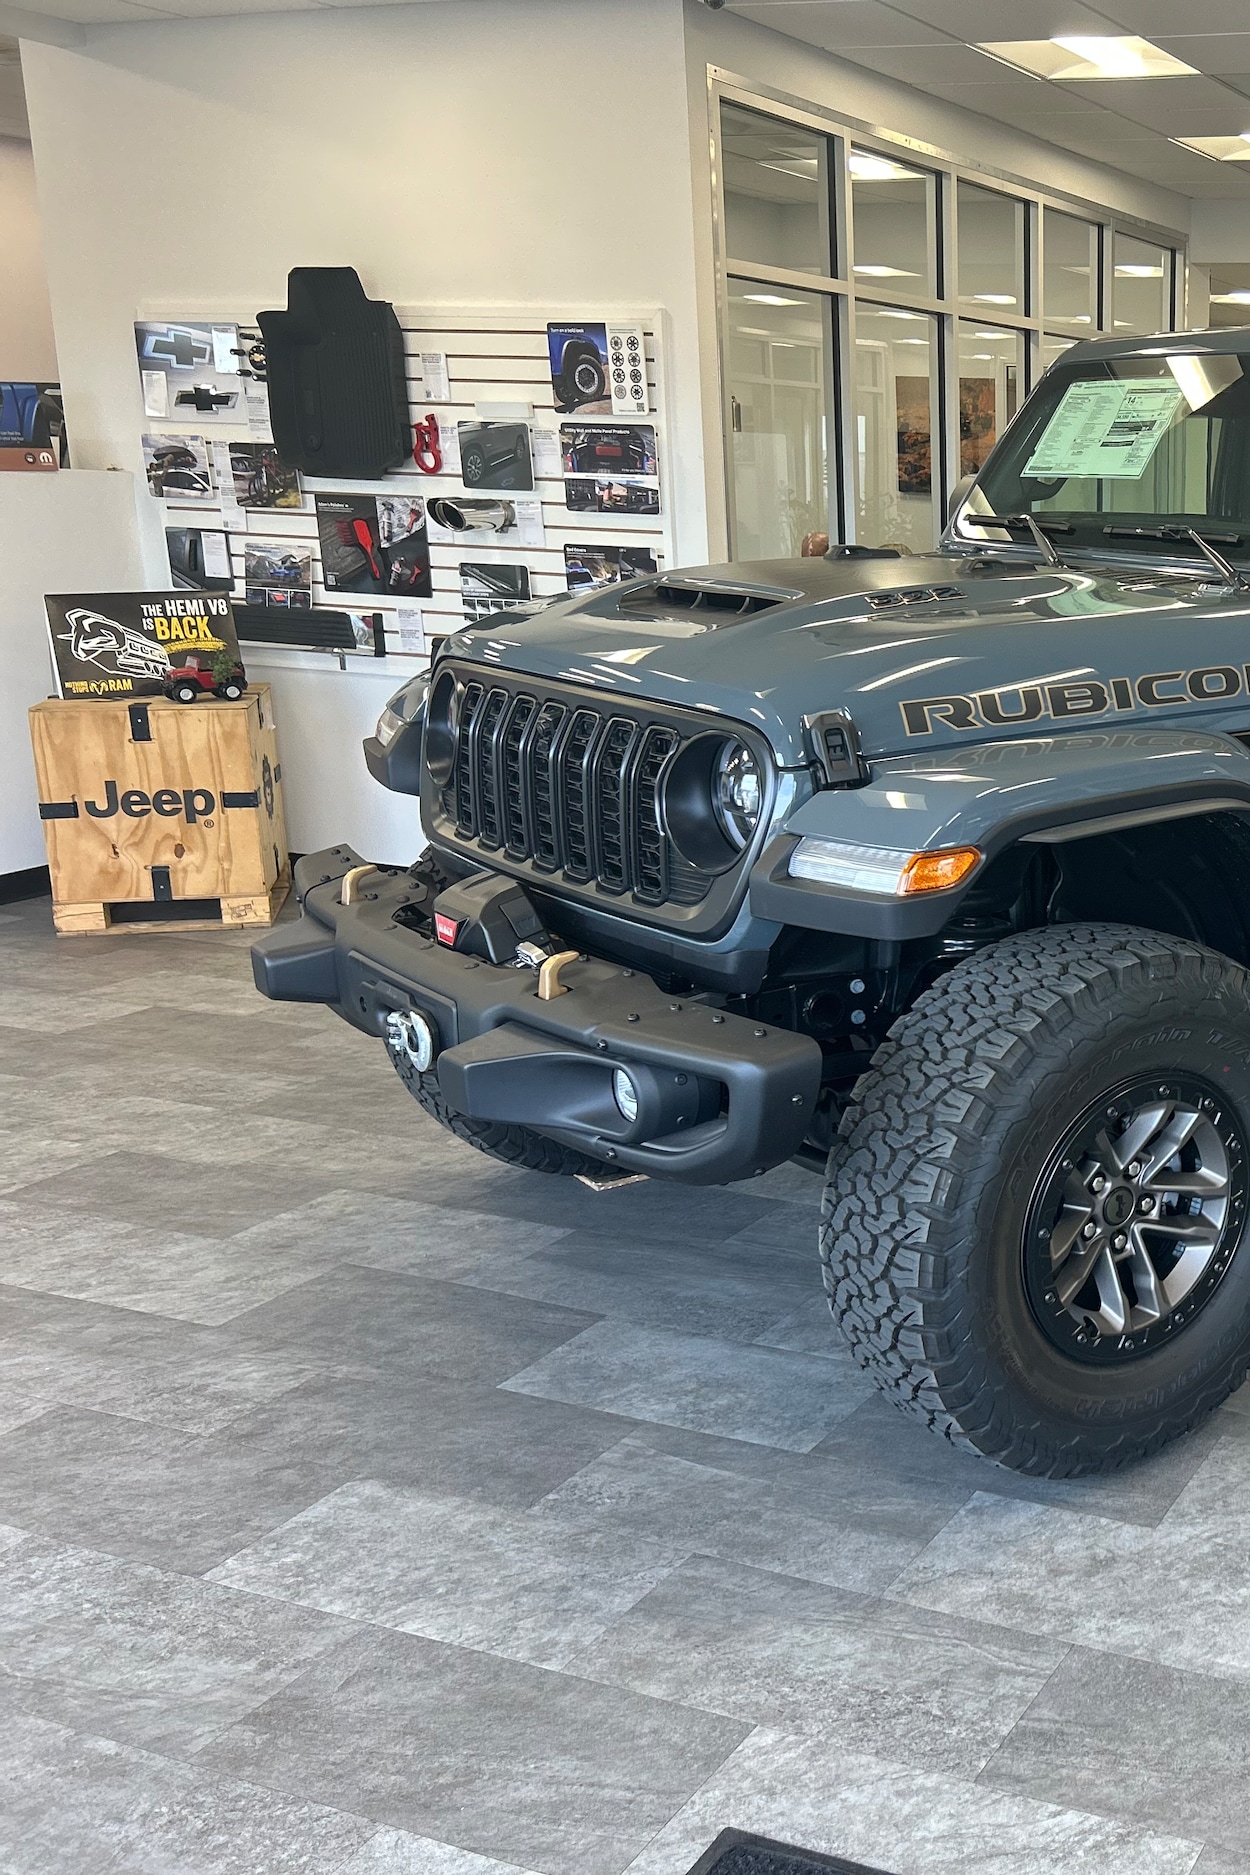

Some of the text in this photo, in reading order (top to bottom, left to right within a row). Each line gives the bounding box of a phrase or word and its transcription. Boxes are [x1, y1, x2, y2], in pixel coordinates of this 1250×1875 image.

[140, 598, 229, 616] THE HEMI V8
[142, 616, 213, 640] IS BACK
[108, 679, 133, 691] RAM
[84, 780, 215, 824] Jeep
